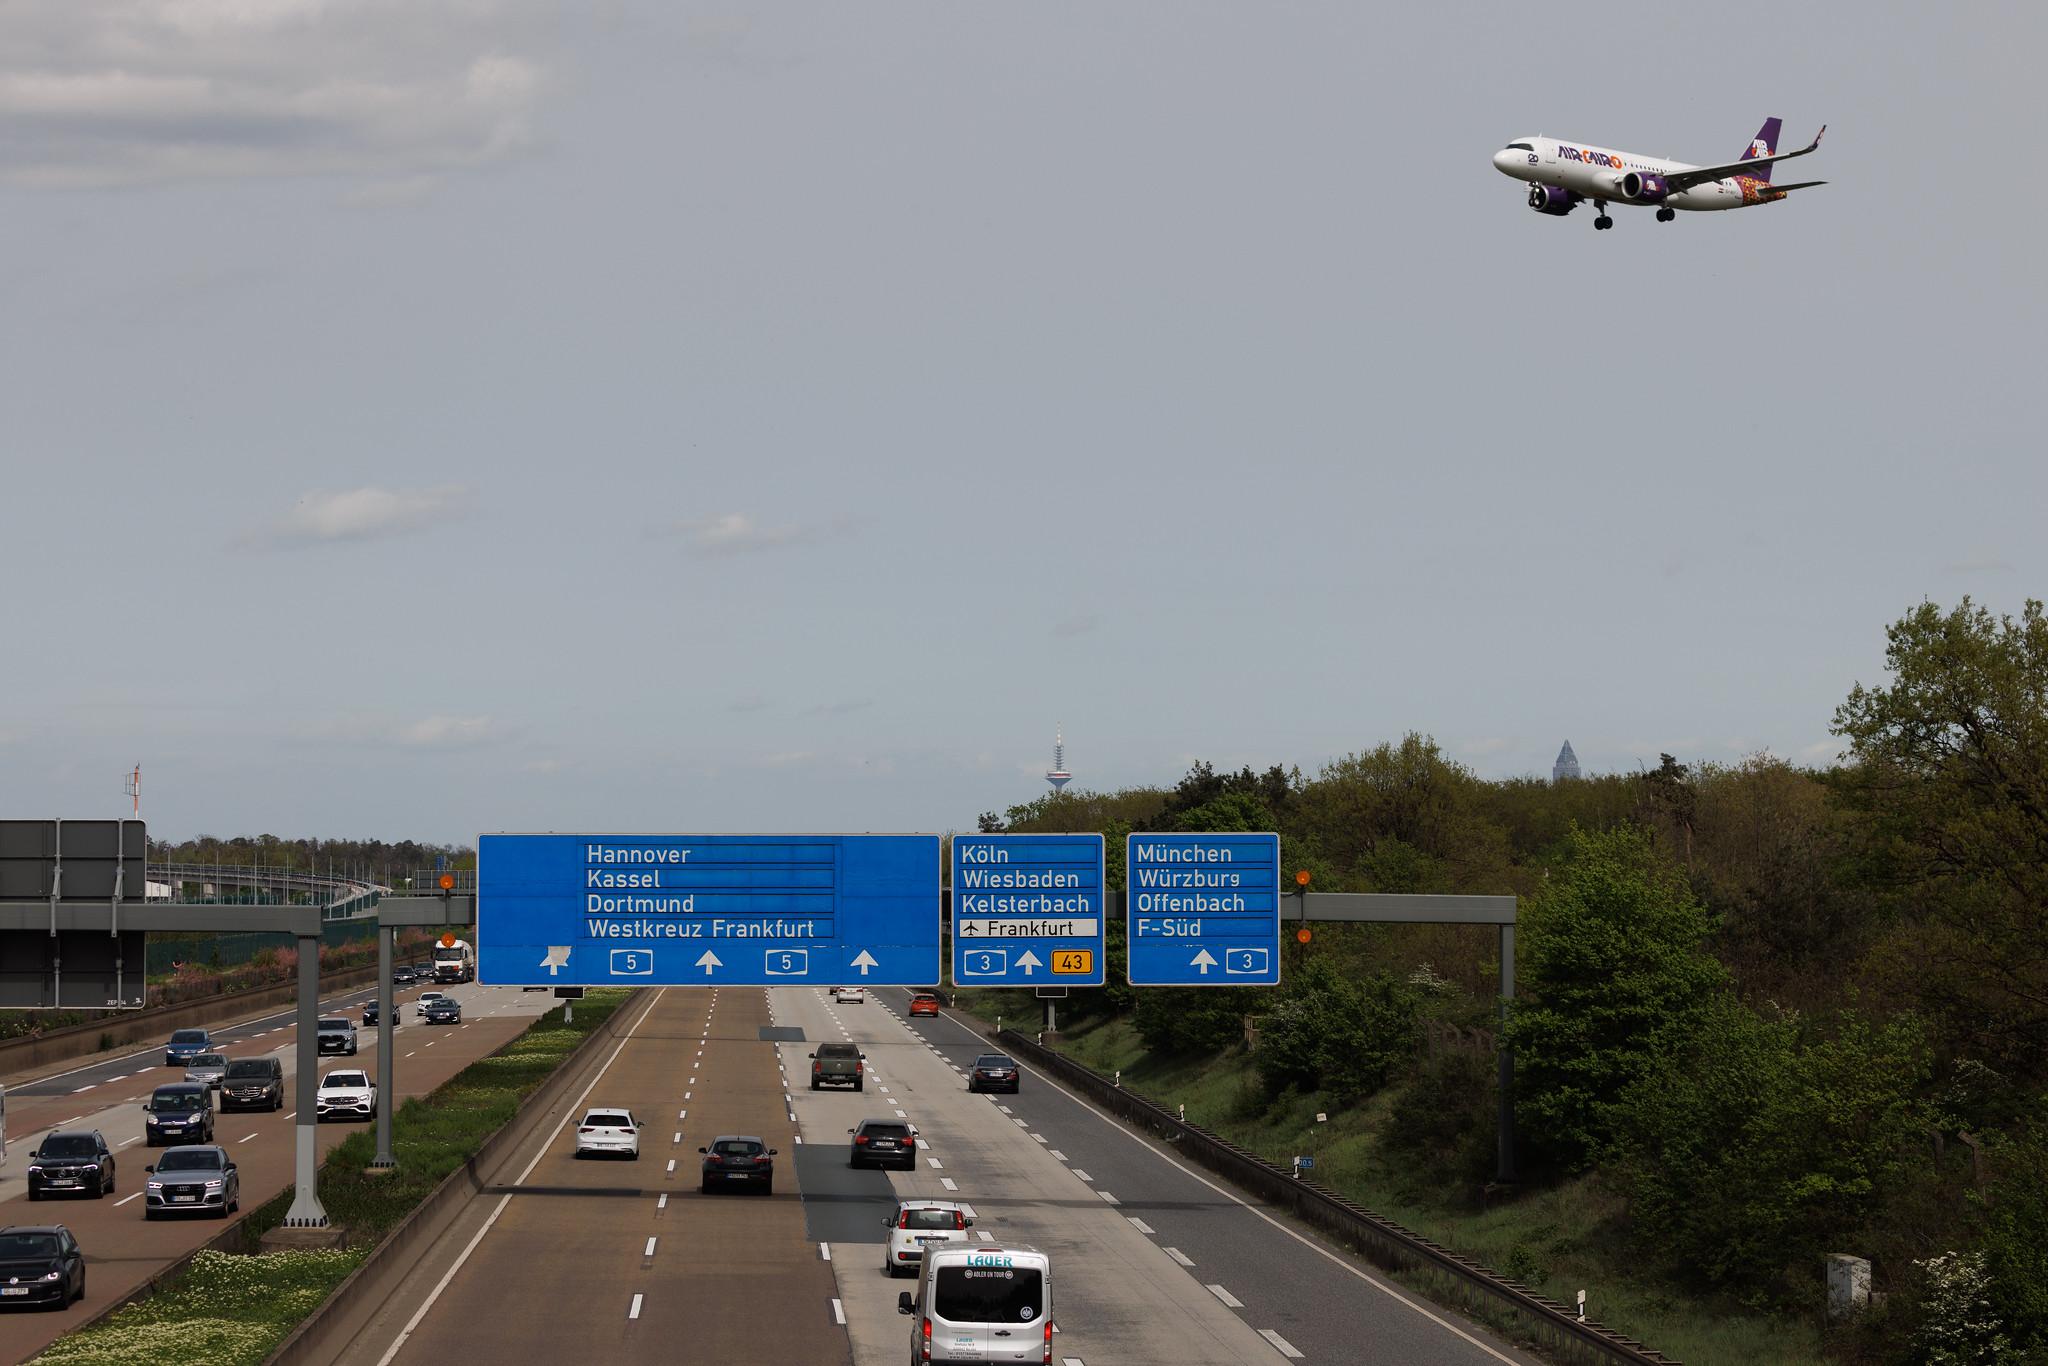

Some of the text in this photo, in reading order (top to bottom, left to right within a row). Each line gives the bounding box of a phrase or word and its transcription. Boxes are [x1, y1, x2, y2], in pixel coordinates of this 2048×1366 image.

[588, 844, 691, 863] Hannover
[962, 845, 1009, 864] Köln
[1137, 844, 1232, 863] München
[588, 869, 661, 888] Kassel
[963, 869, 1079, 888] Wiesbaden
[1138, 868, 1240, 888] Würzburg
[587, 894, 694, 913] Dortmund
[962, 894, 1089, 913] Kelsterbach
[1138, 893, 1245, 912] Offenbach
[588, 919, 814, 938] Westkreuz Frankfurt
[988, 920, 1073, 936] Frankfurt
[1138, 918, 1201, 937] F-Süd
[626, 954, 636, 970] 5
[782, 954, 791, 970] 5
[980, 955, 991, 970] 3
[1062, 954, 1082, 970] 43
[1243, 954, 1252, 969] 3
[967, 1255, 1013, 1268] LAUER
